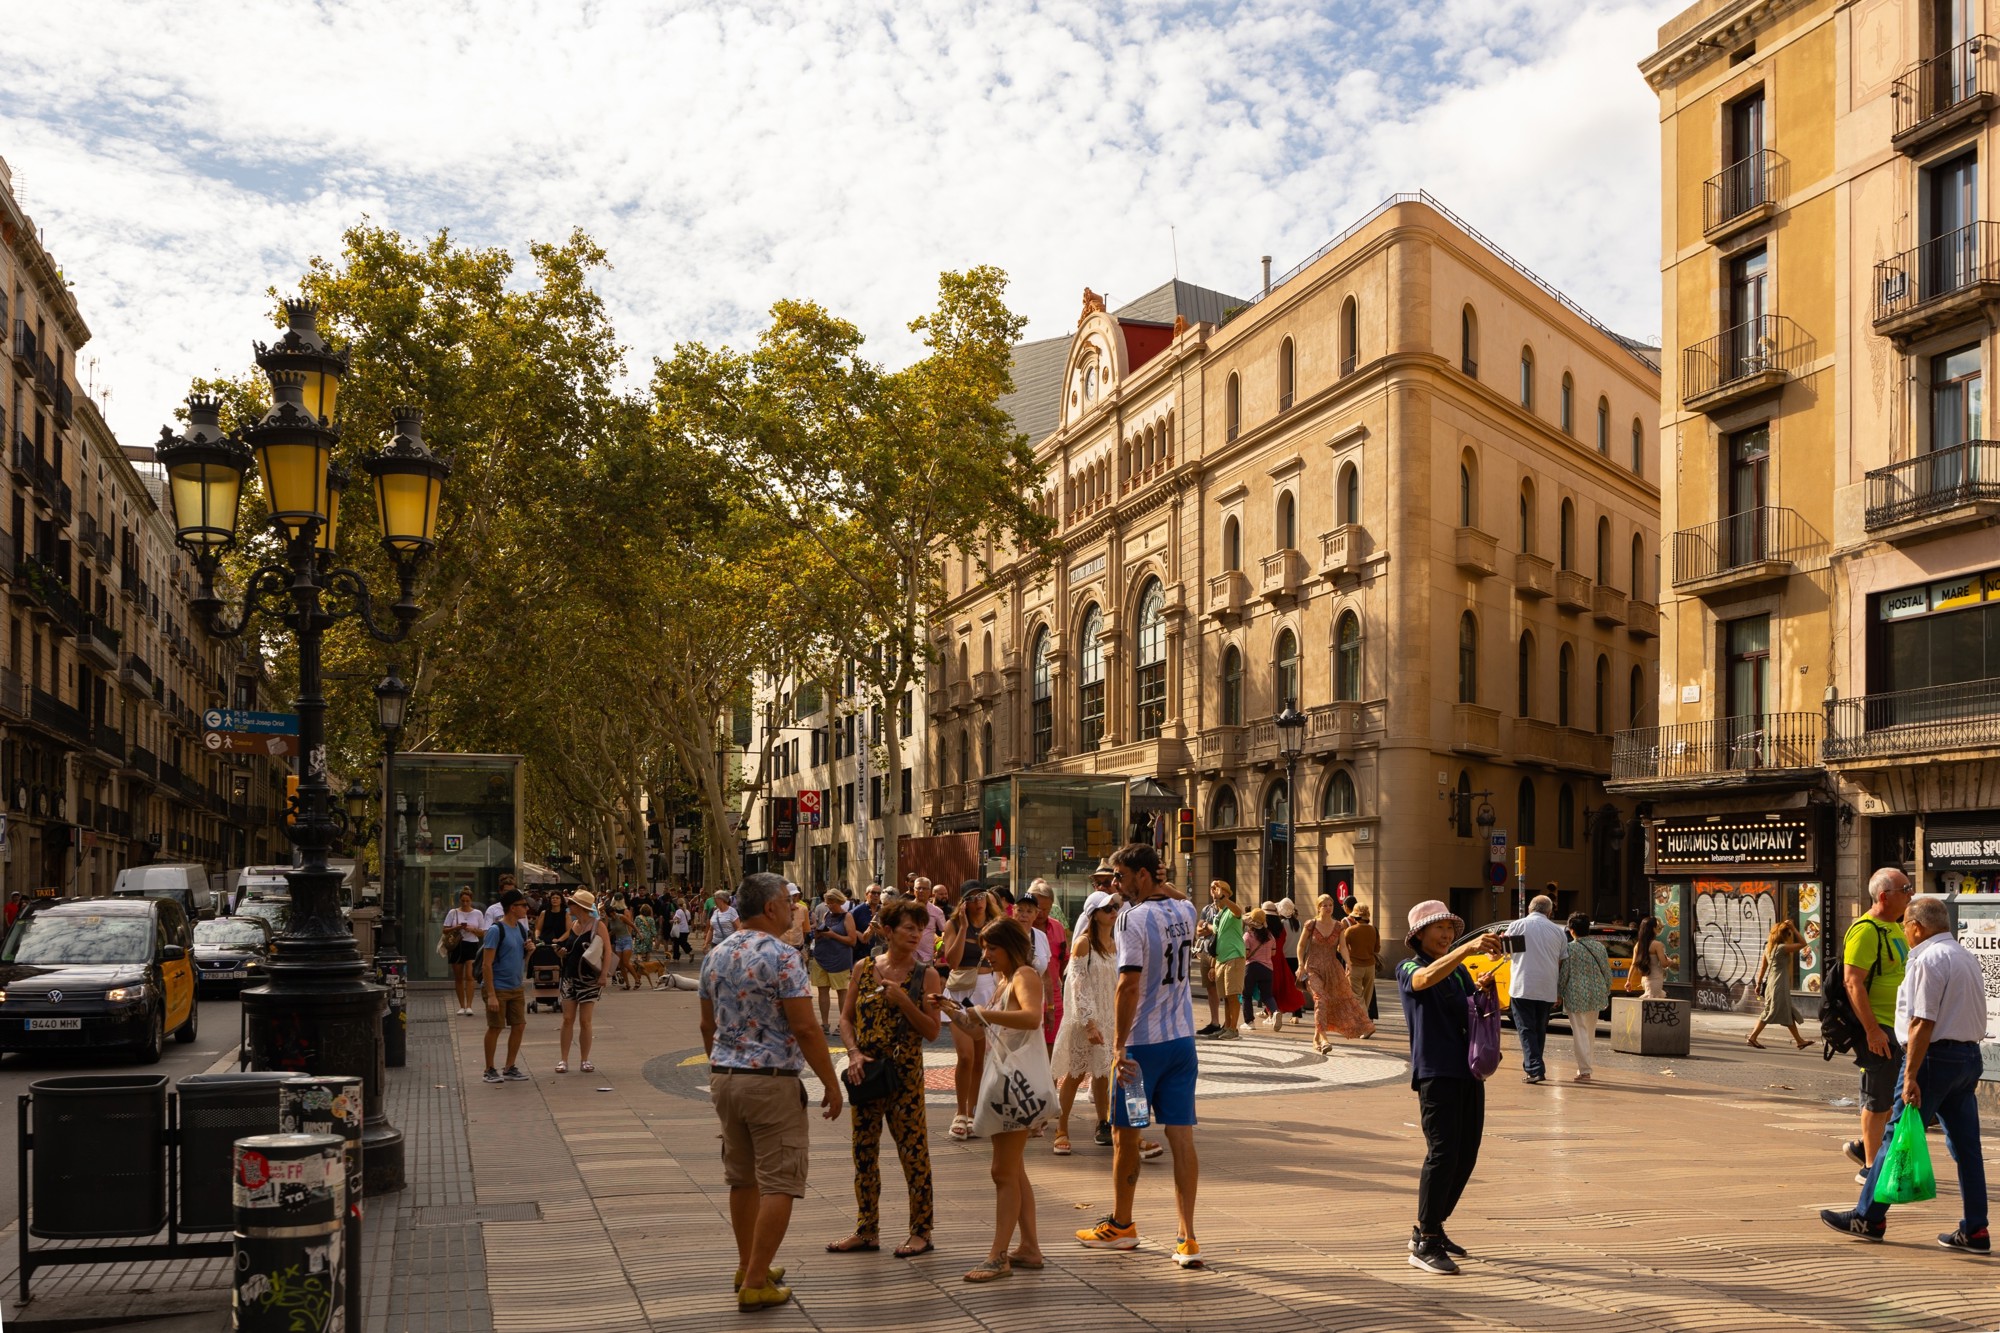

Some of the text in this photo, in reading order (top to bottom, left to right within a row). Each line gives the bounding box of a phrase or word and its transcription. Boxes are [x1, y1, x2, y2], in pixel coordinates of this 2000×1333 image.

[1888, 594, 1924, 611] HOSTAL
[1941, 585, 1970, 601] MARE
[1800, 665, 1809, 675] 67
[256, 719, 272, 727] Josep
[995, 828, 1002, 846] M
[1668, 831, 1794, 852] HUMMUS & COMPANY
[1930, 840, 1982, 858] SOUVENIRS
[1711, 854, 1746, 863] lebanese grill
[1965, 883, 1971, 892] 7
[1164, 921, 1190, 939] MESSI
[1162, 939, 1192, 985] 10
[32, 1019, 80, 1028] 9440 MHK
[1644, 1011, 1681, 1027] ACAB
[1850, 1219, 1870, 1234] AX
